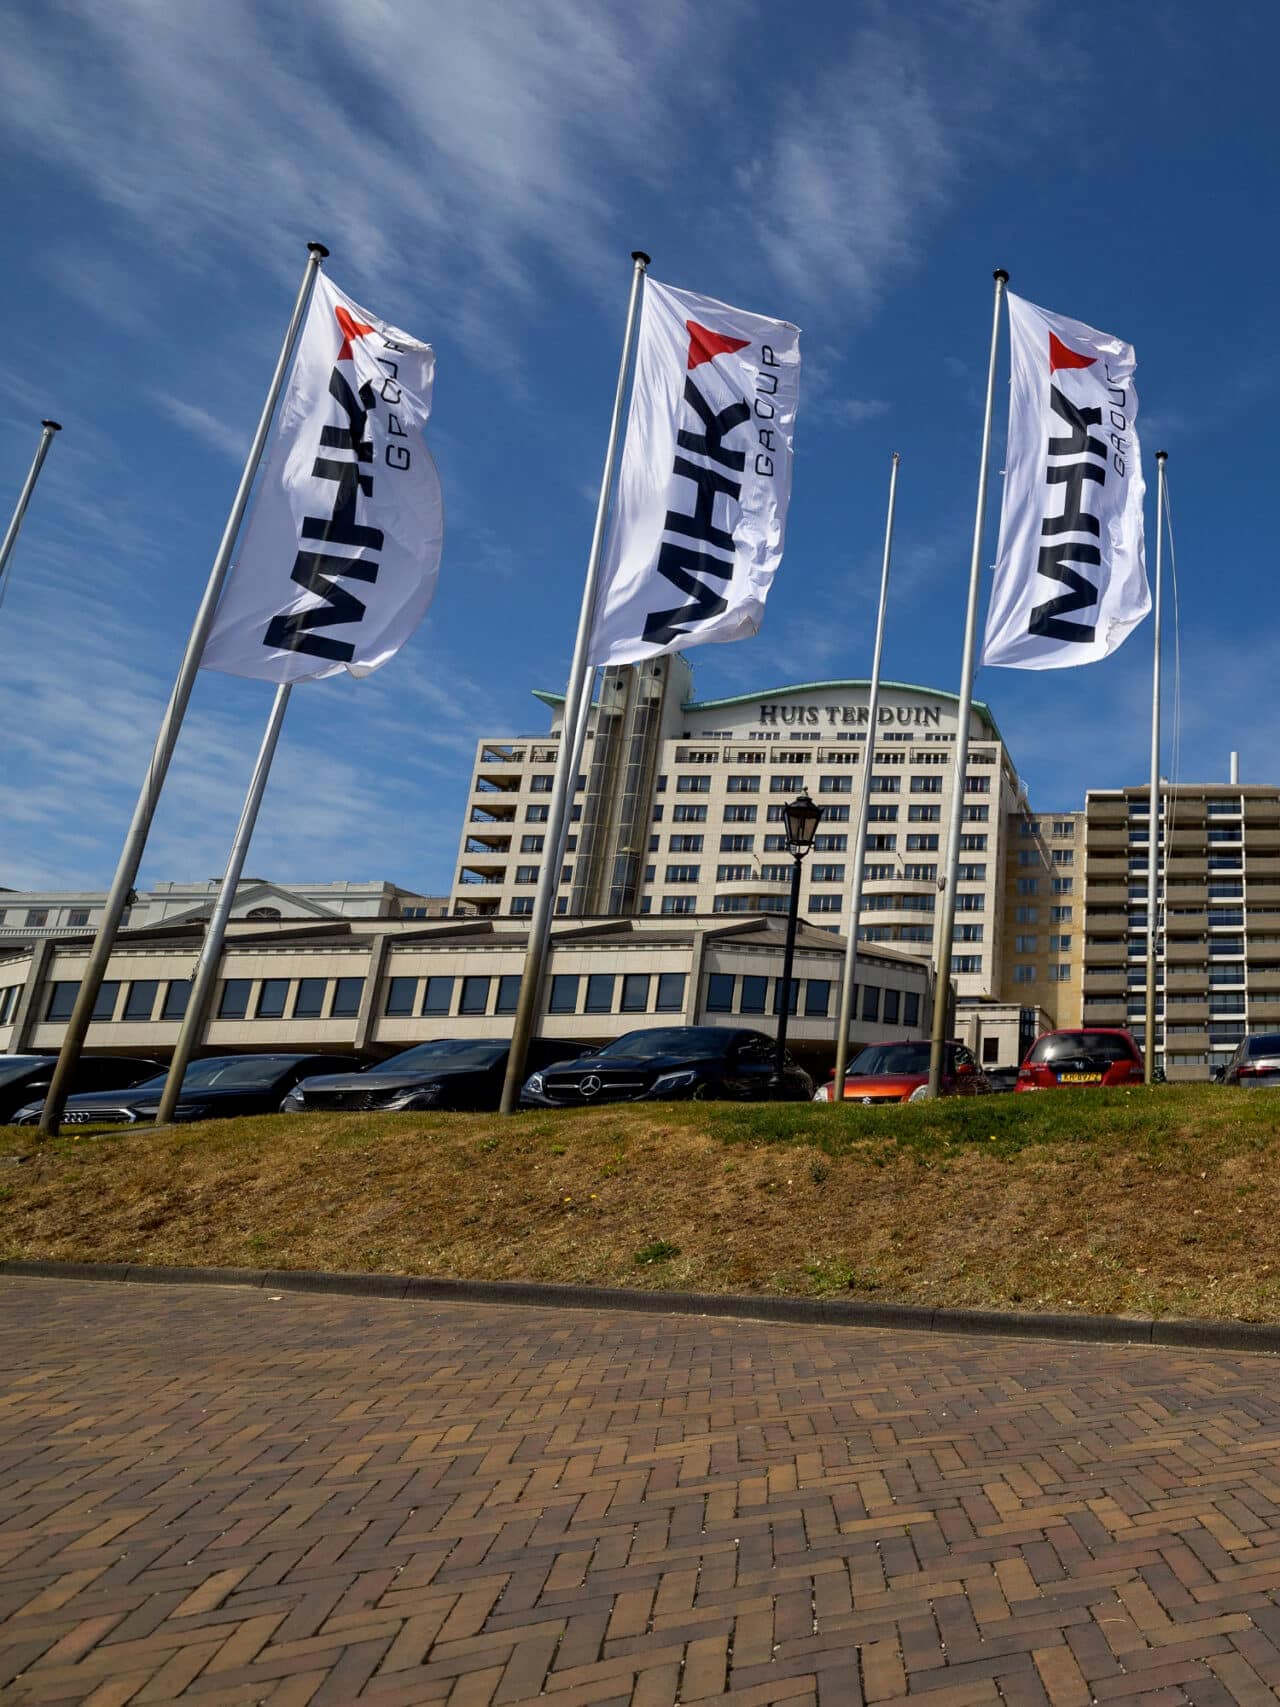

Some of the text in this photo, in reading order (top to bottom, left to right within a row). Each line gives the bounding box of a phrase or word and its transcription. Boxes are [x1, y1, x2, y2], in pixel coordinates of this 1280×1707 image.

[263, 367, 384, 663] MHK
[641, 376, 751, 645] MHK
[754, 344, 781, 477] GROUP
[1028, 384, 1107, 642] MHK
[759, 705, 942, 726] HUIS TER DUIN
